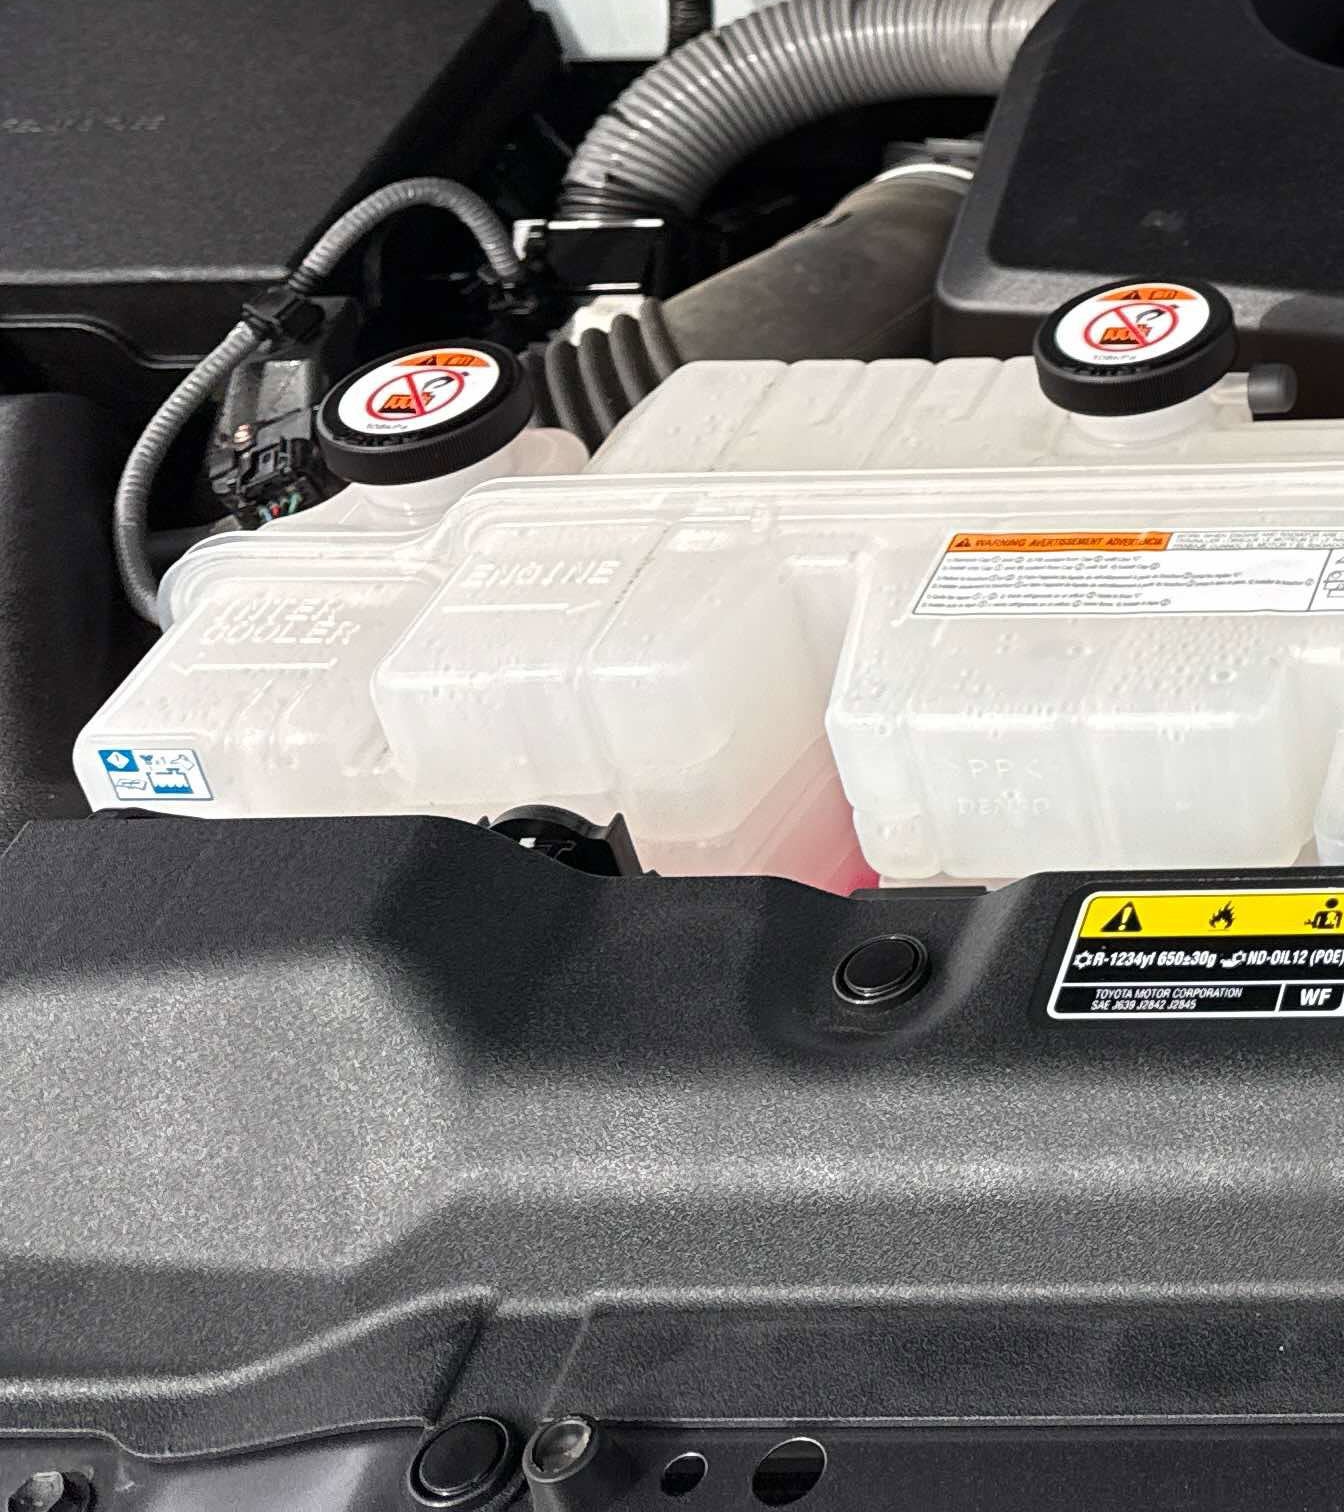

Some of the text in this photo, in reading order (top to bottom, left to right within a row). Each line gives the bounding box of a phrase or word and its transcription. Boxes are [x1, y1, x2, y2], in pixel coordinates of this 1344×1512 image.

[460, 559, 621, 589] ENGINE
[200, 621, 361, 646] COOLER
[1092, 951, 1157, 969] R-1234yf
[1157, 950, 1218, 969] 650±30g
[1095, 987, 1244, 999] TOYOTA MOTOR CORPORATION
[1300, 987, 1333, 1007] WF
[1090, 999, 1111, 1011] SAE
